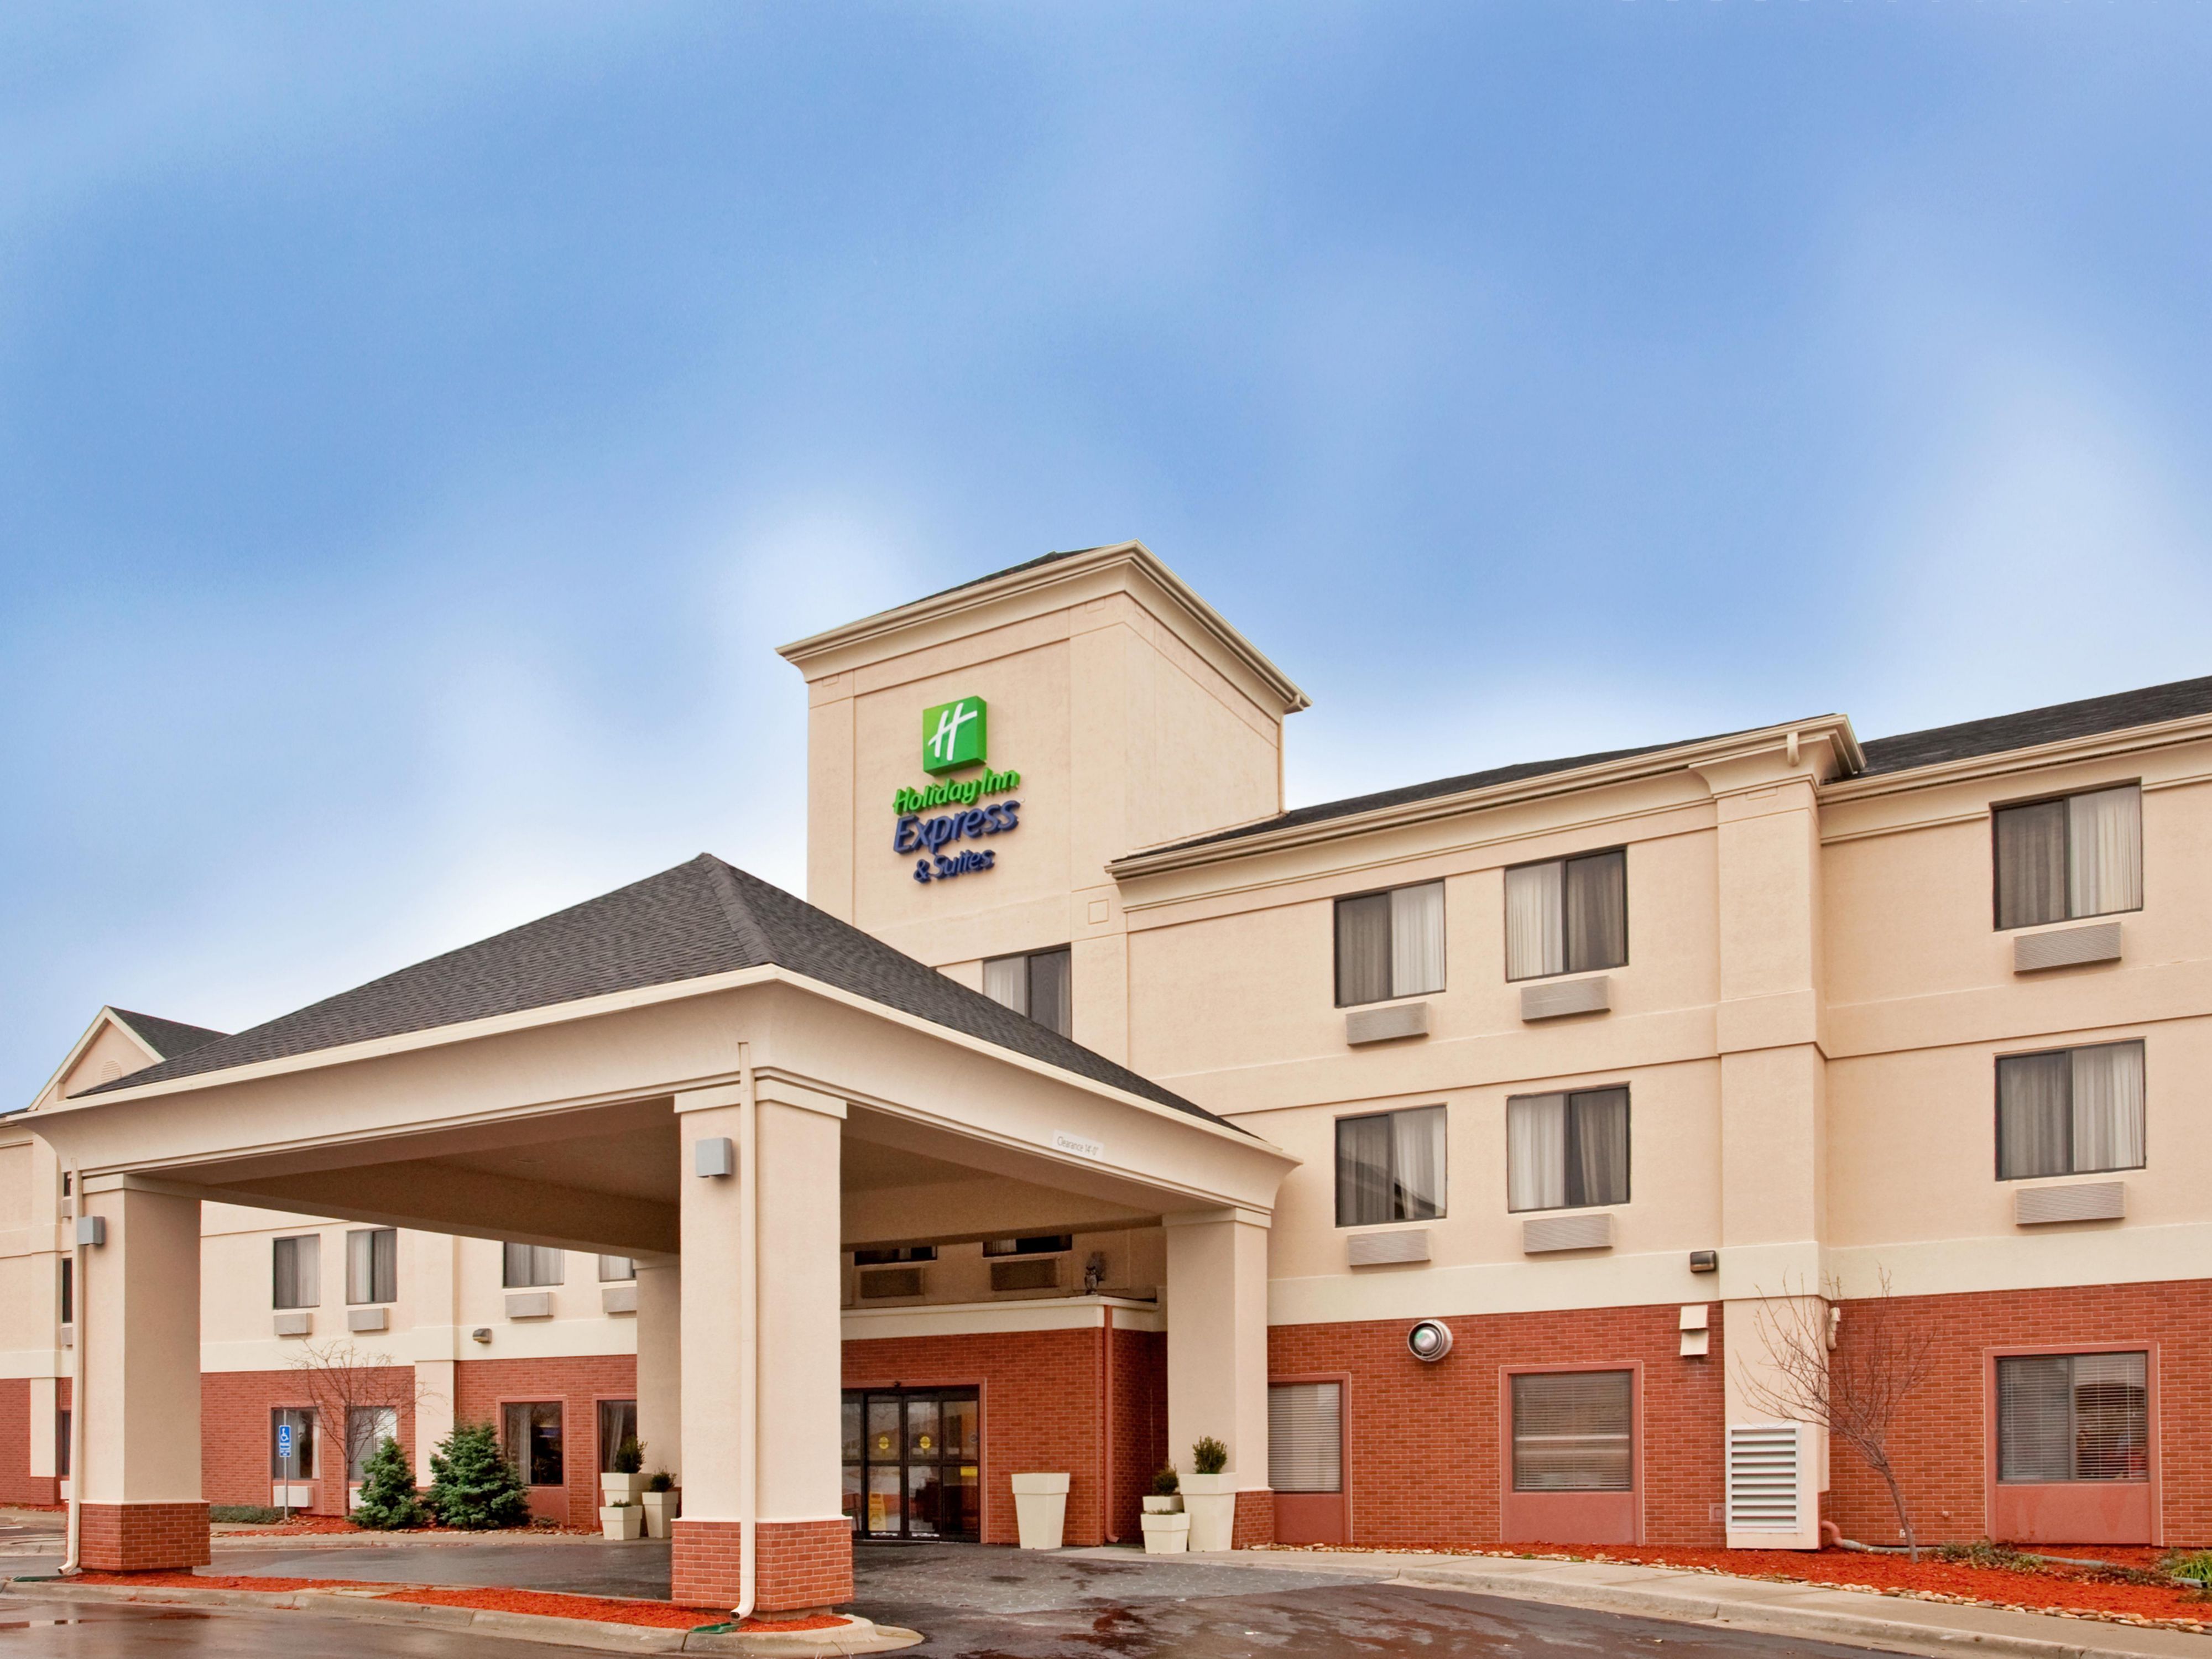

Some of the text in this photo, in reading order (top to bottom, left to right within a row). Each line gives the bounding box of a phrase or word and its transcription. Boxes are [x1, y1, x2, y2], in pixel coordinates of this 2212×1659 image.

[893, 767, 1020, 816] Holiday Inn
[893, 800, 1020, 854] Express
[913, 850, 995, 883] & Suites
[1057, 1136, 1083, 1152] Clearance
